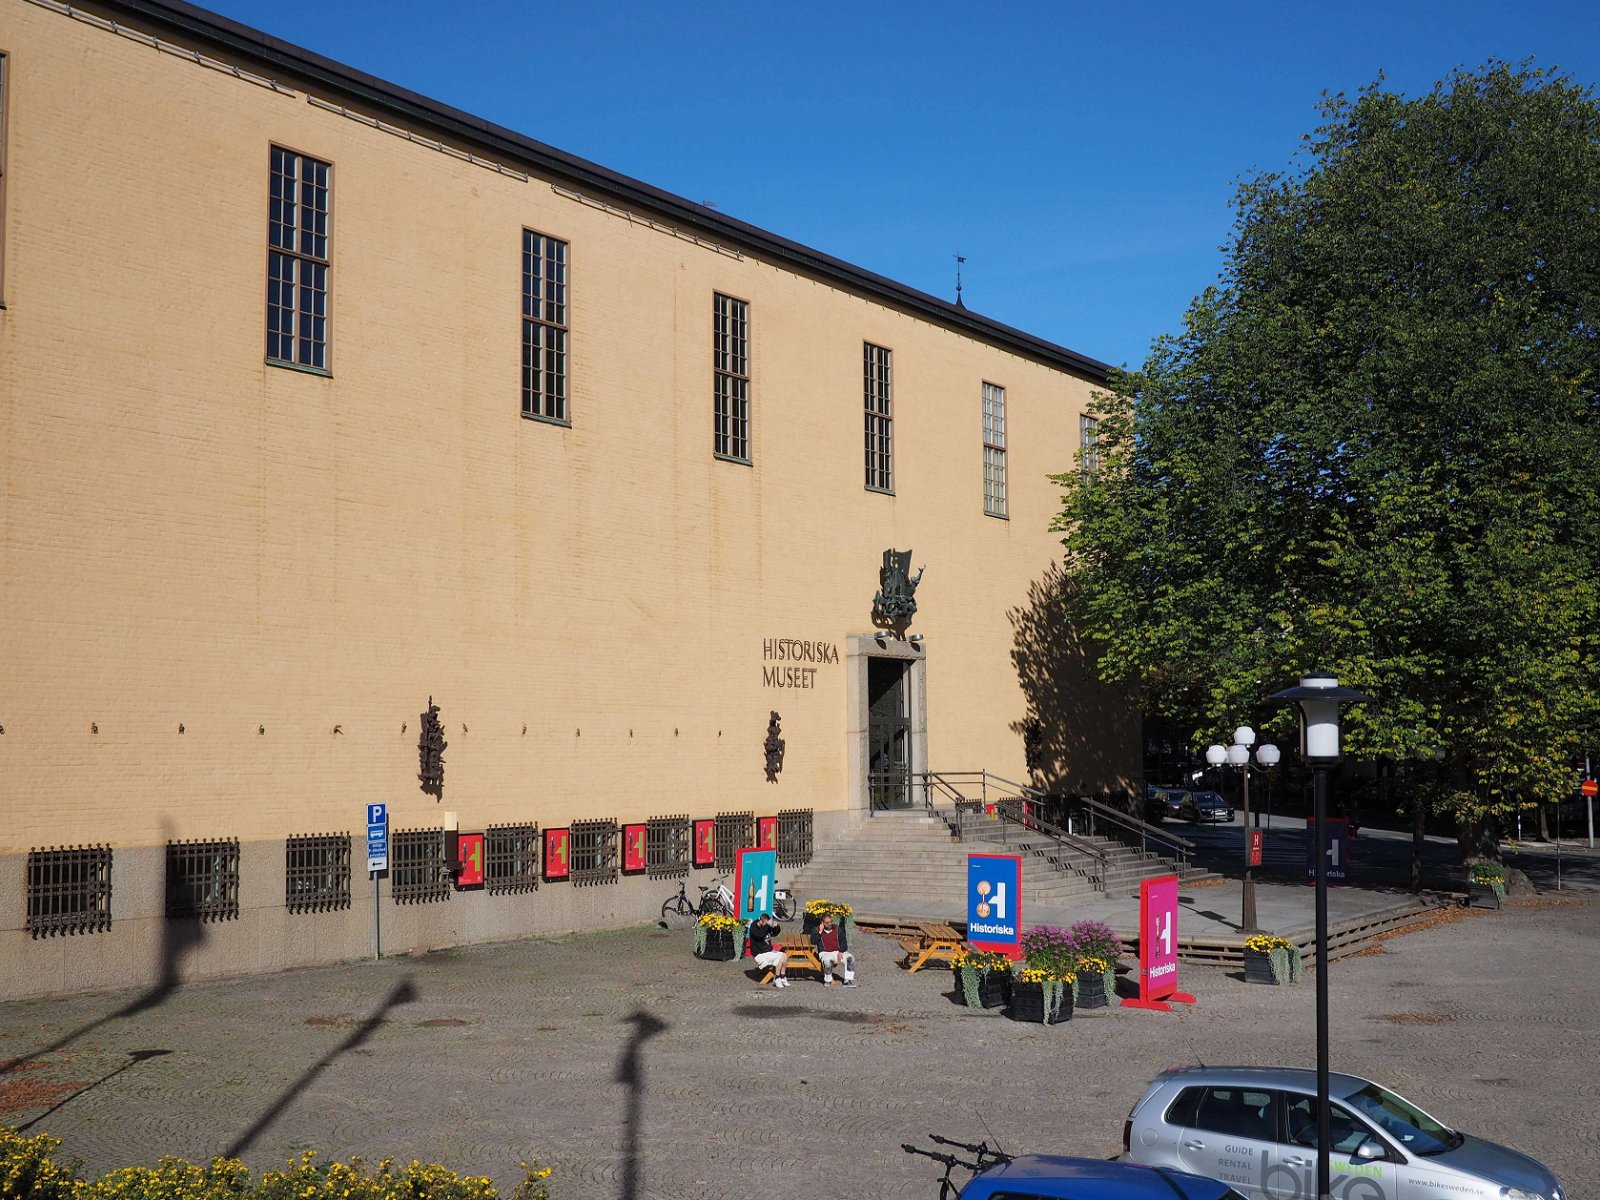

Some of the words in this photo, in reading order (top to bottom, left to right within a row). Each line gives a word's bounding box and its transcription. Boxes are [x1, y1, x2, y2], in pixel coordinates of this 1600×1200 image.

[763, 638, 839, 664] HISTORISKA
[763, 666, 817, 689] MUSEET
[372, 805, 382, 823] P
[970, 922, 1014, 935] Historiska
[1149, 961, 1176, 979] Historiska
[1225, 1144, 1254, 1156] GUIDE
[1218, 1158, 1252, 1170] RENTAL
[1218, 1172, 1252, 1185] TRAVEL
[1408, 1178, 1485, 1195] www.bikesweden.se
